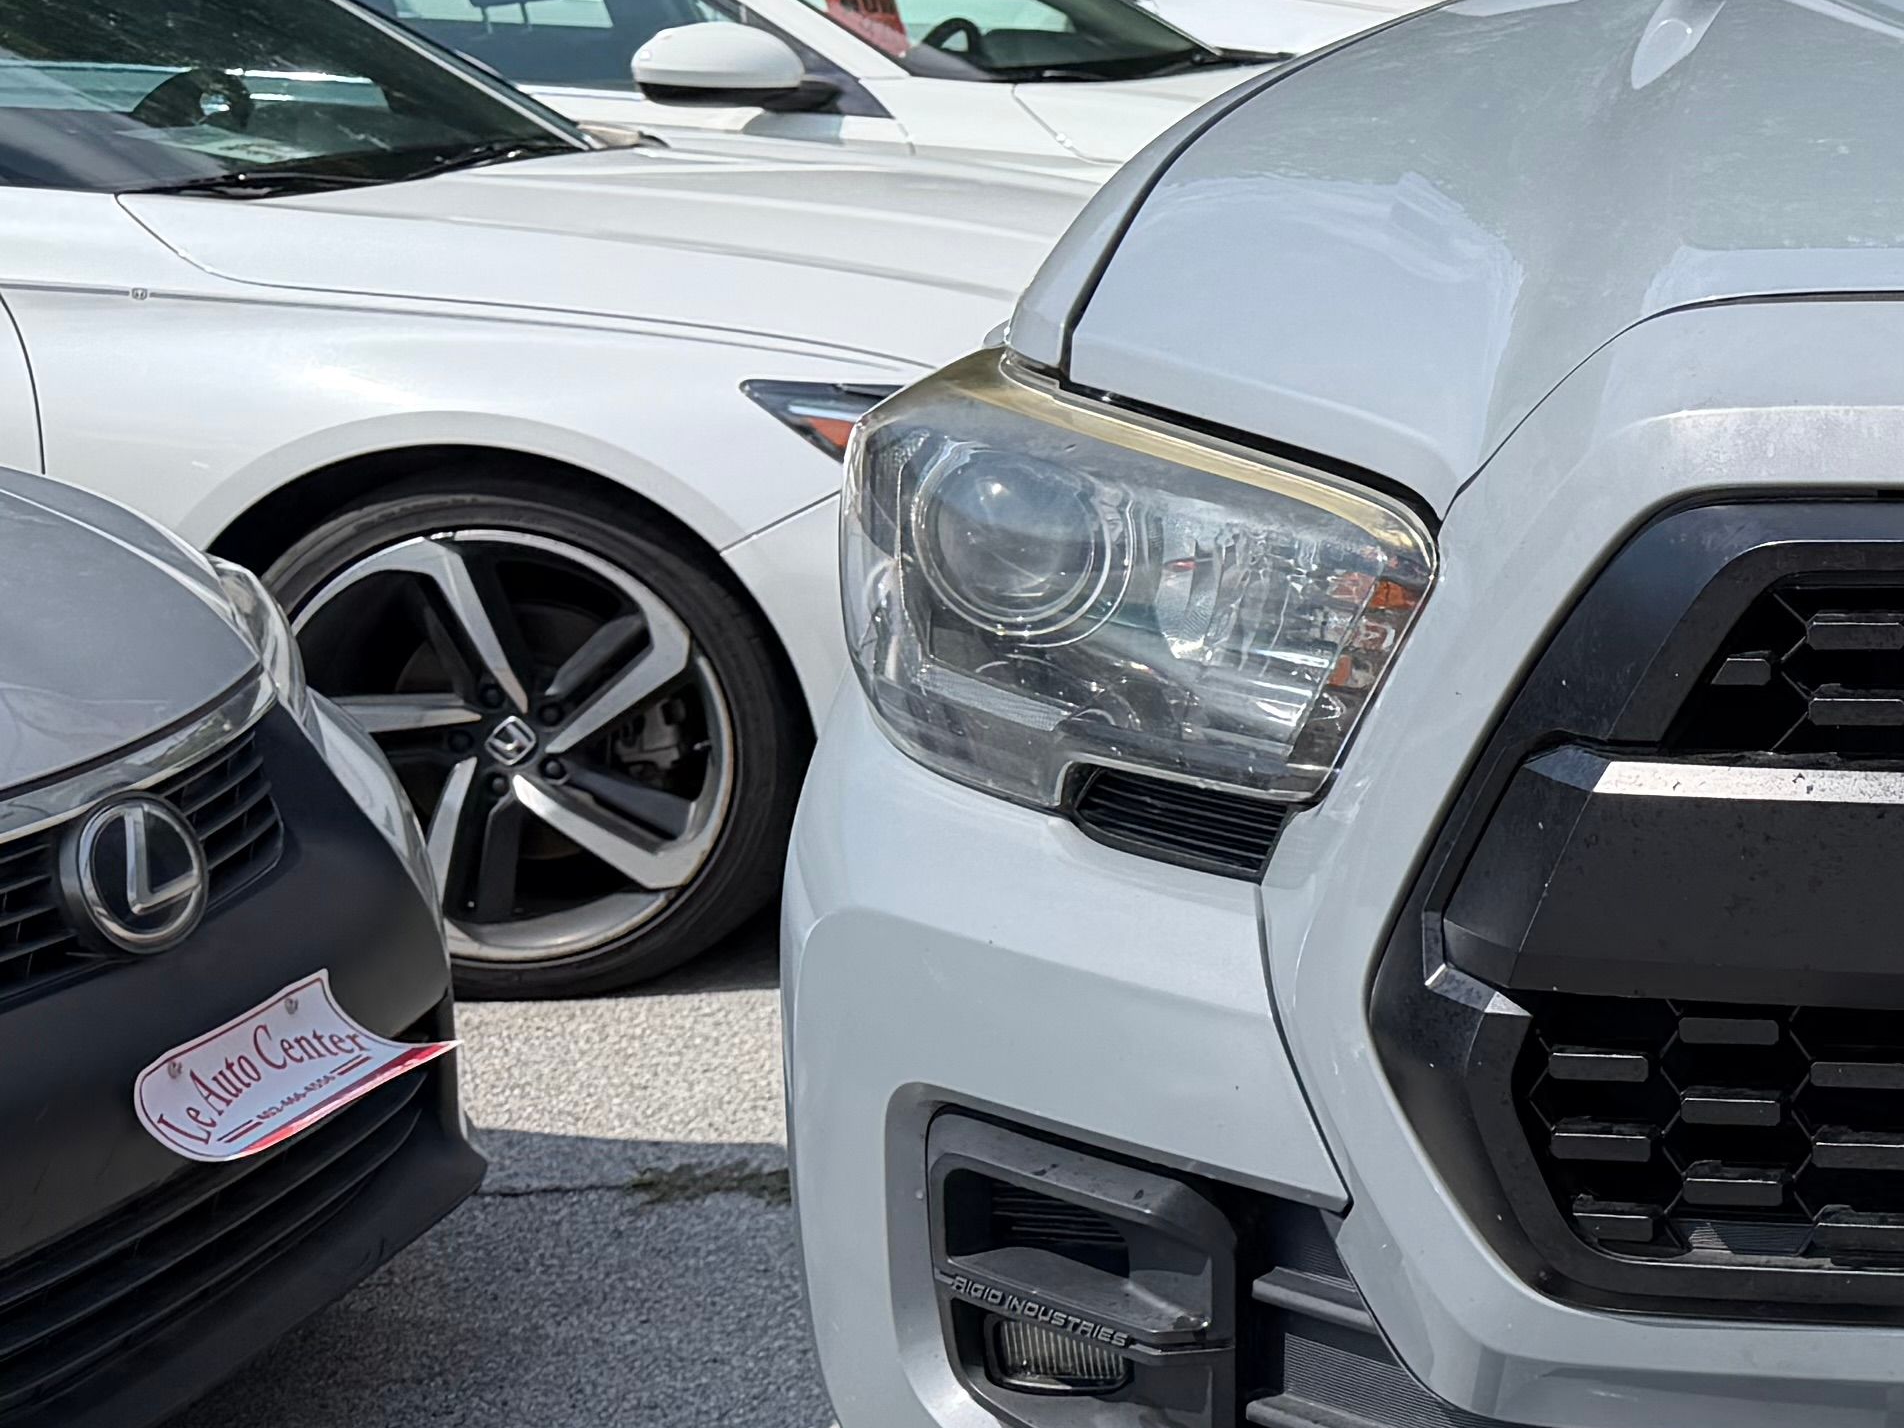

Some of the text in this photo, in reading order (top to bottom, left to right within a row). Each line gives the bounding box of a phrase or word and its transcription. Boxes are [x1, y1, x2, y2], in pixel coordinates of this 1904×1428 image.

[157, 1105, 217, 1145] Le
[189, 1053, 262, 1117] Auto
[253, 1024, 371, 1070] Center
[951, 1275, 1130, 1348] RIGID INDUSTRIES
